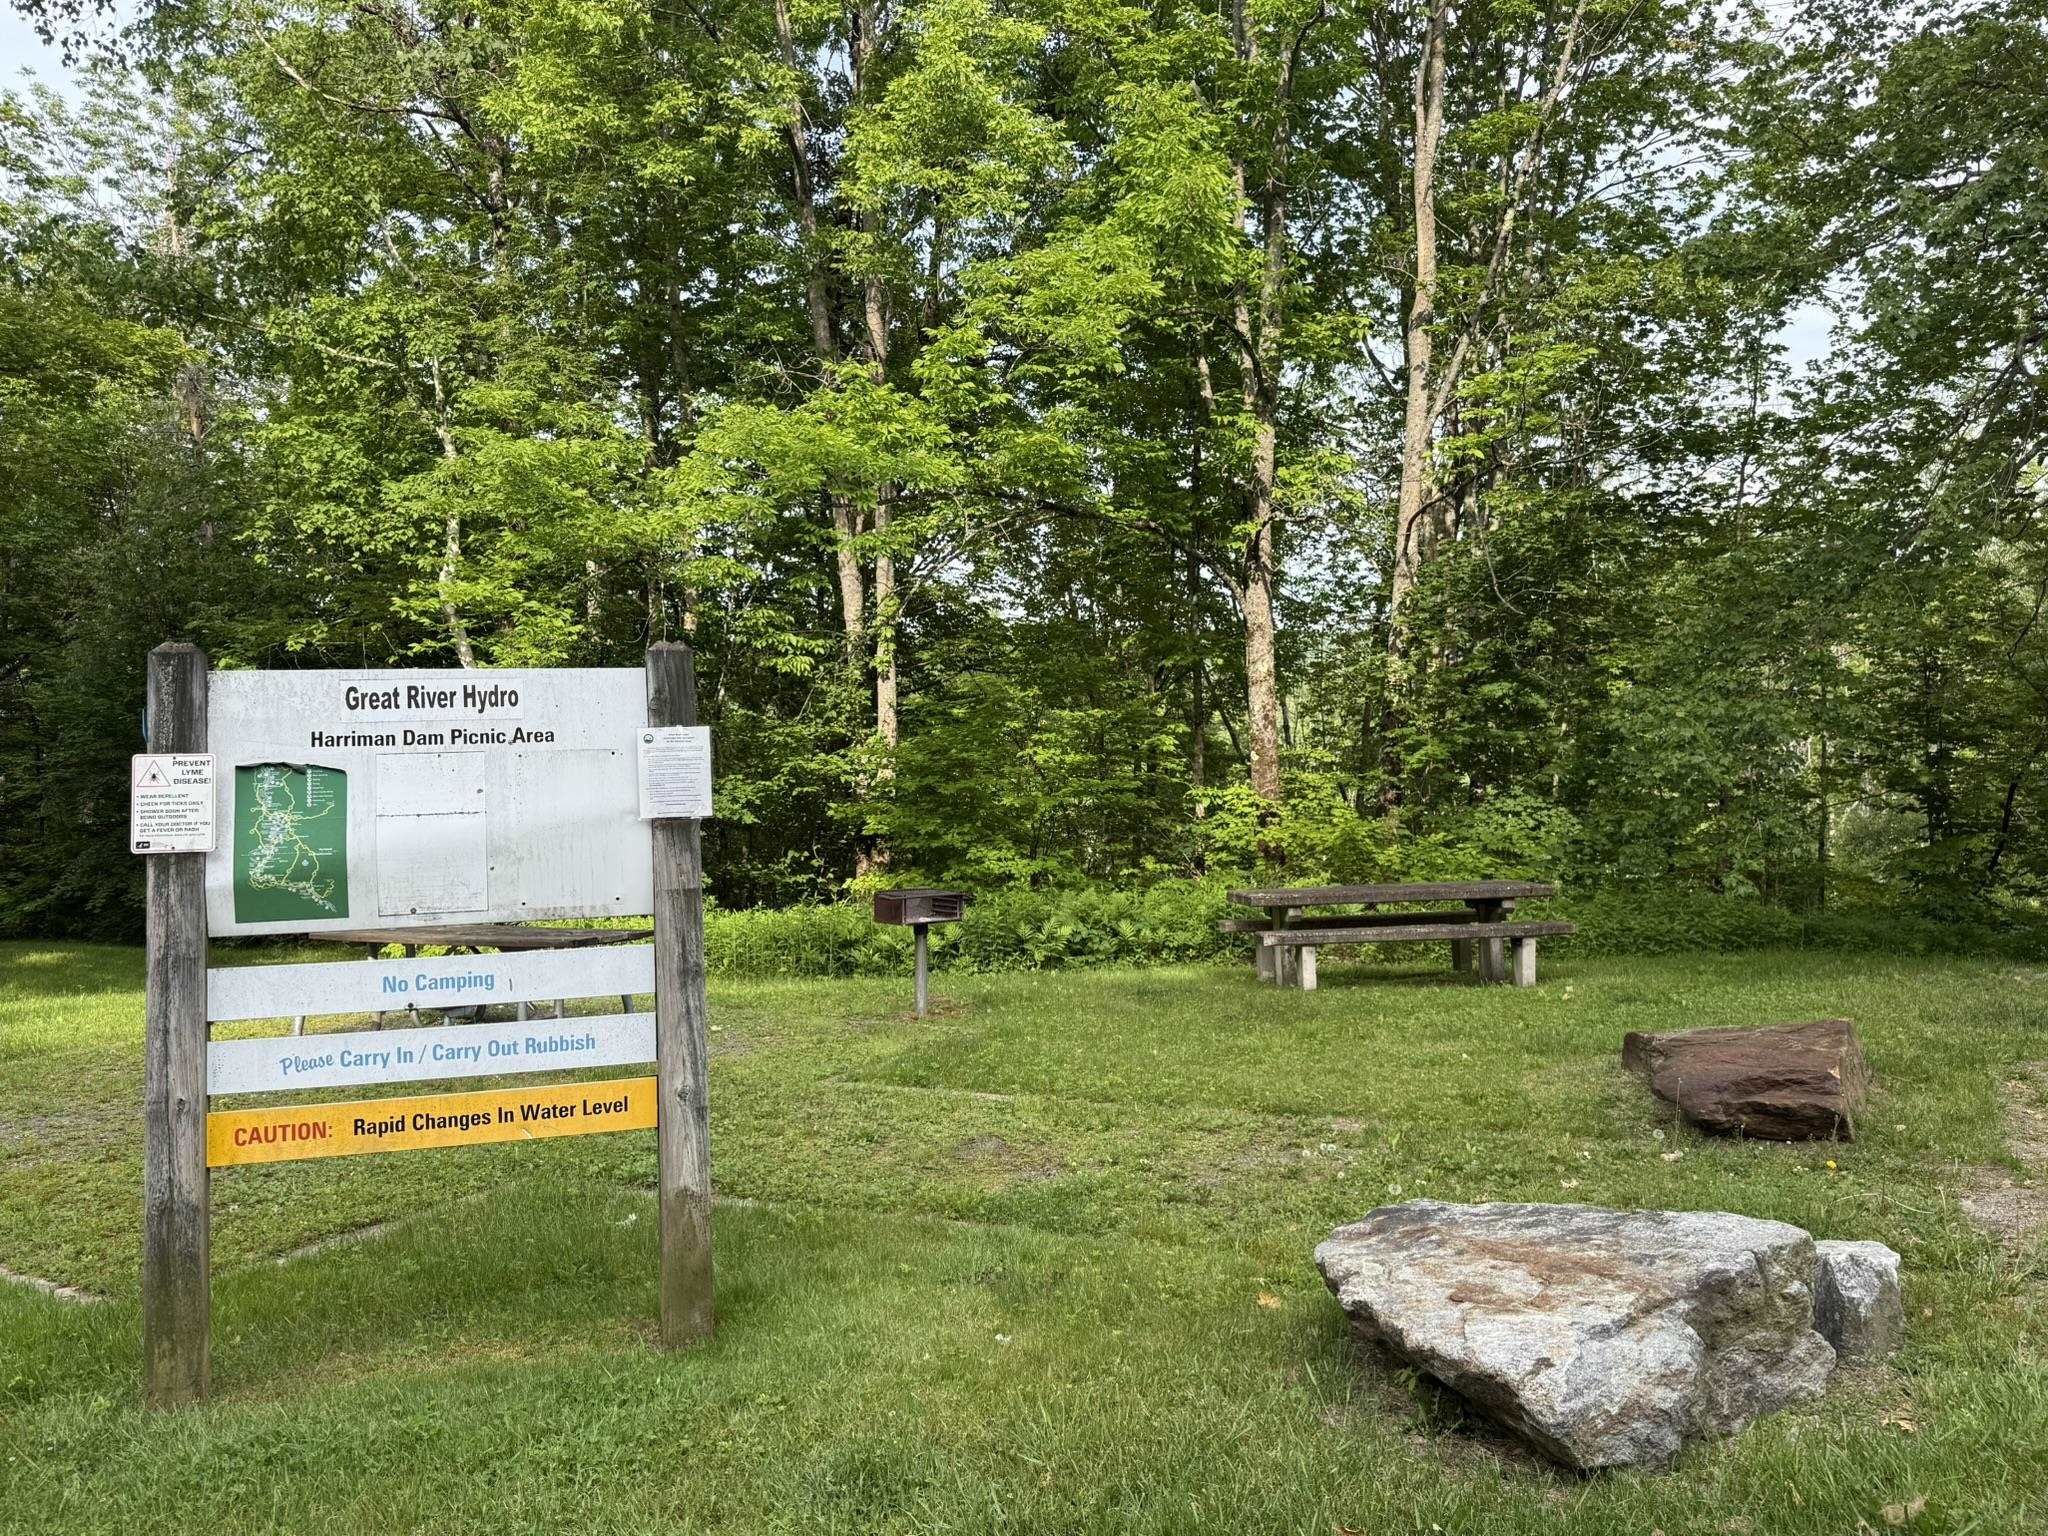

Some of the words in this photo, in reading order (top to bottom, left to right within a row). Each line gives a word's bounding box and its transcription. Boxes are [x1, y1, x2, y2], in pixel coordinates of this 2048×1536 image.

[345, 686, 400, 710] Great
[407, 685, 456, 709] River
[463, 684, 519, 714] Hydro
[311, 730, 396, 747] Harriman
[403, 729, 444, 746] Dam
[450, 728, 506, 745] Picnic
[513, 726, 555, 743] Area
[173, 777, 211, 785] DISEASE!
[382, 975, 409, 993] No
[415, 971, 495, 992] Camping
[279, 1054, 335, 1076] Please
[340, 1050, 391, 1069] Carry
[396, 1046, 414, 1063] In
[418, 1044, 427, 1065] /
[432, 1043, 482, 1062] Carry
[488, 1039, 519, 1057] Out
[525, 1033, 596, 1054] Rubbish
[234, 1121, 333, 1147] CAUTION:
[353, 1114, 405, 1138] Rapid
[412, 1110, 492, 1131] Changes
[498, 1106, 514, 1124] In
[520, 1103, 577, 1121] Water
[582, 1095, 629, 1116] Level
